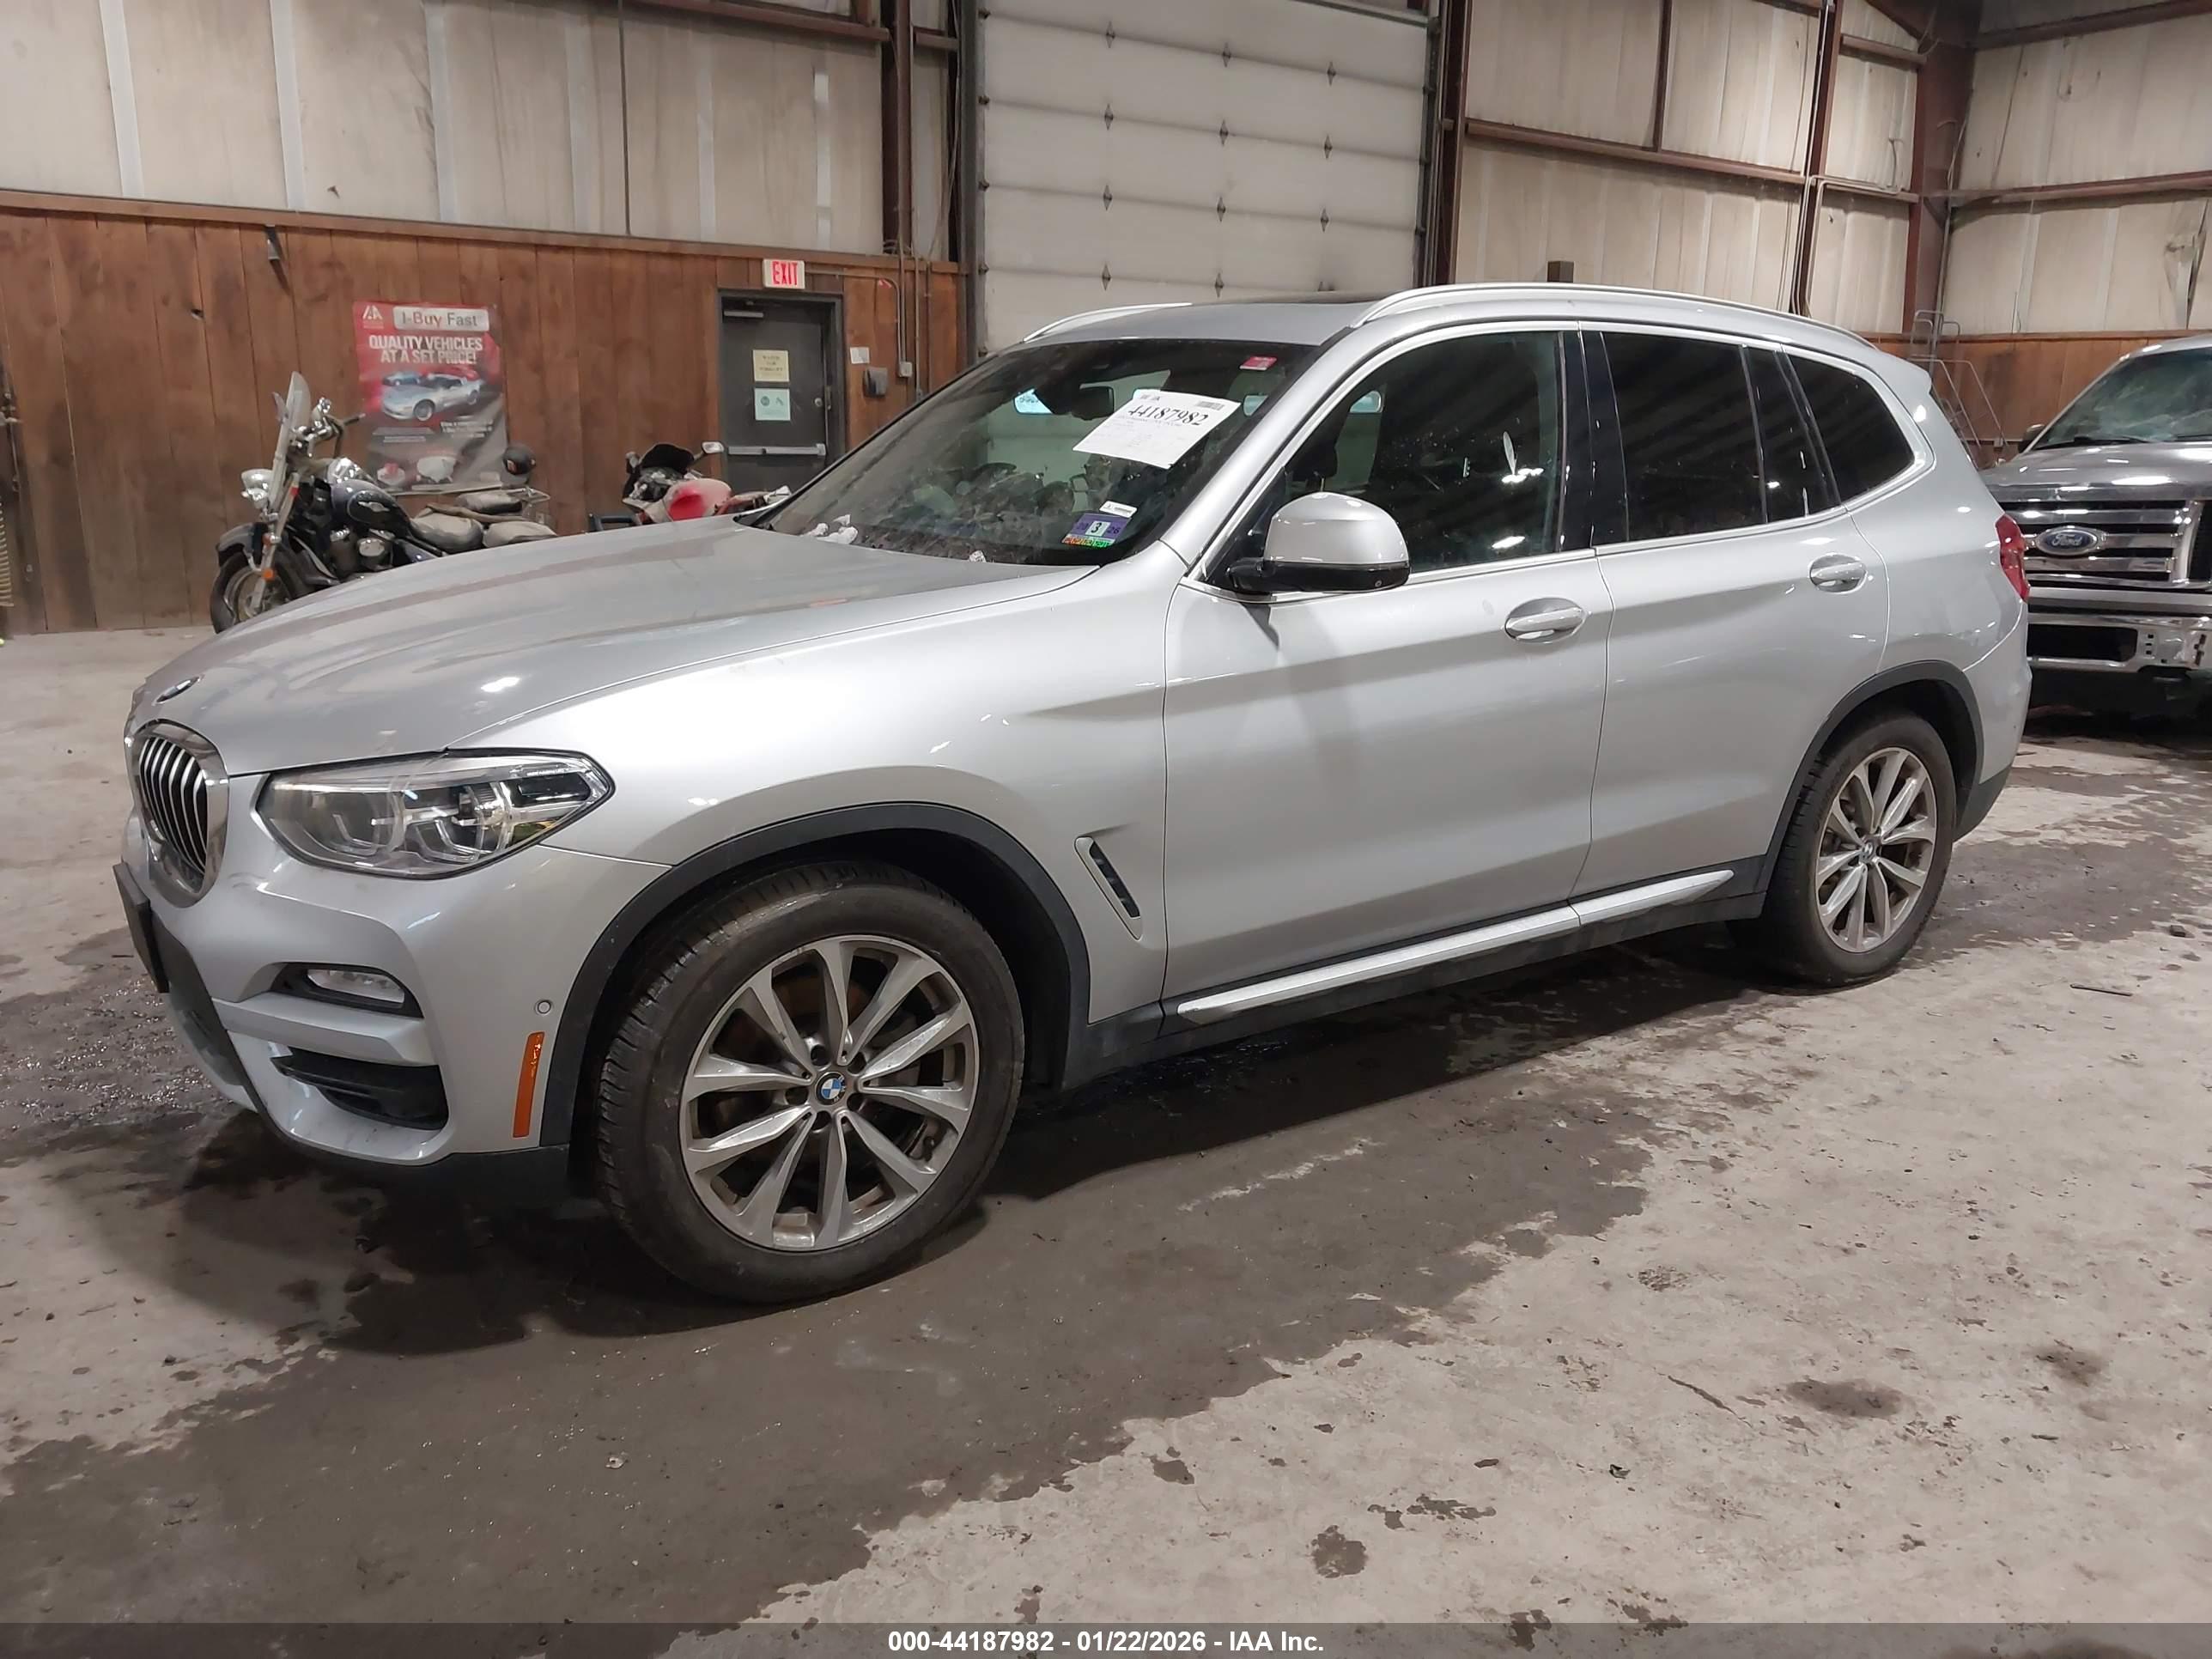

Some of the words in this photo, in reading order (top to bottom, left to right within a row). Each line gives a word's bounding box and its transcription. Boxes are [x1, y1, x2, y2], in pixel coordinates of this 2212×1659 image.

[772, 261, 798, 285] EXIT
[402, 312, 442, 328] I-Buy
[447, 313, 477, 326] Fast
[369, 336, 422, 349] QUALITY
[424, 337, 483, 350] VEHICLES
[380, 349, 398, 363] AT
[399, 350, 410, 363] A
[412, 350, 436, 363] SET
[438, 350, 477, 364] PRICE!
[1127, 404, 1209, 426] 44187982
[1091, 522, 1102, 533] 3
[2051, 533, 2082, 546] Ford
